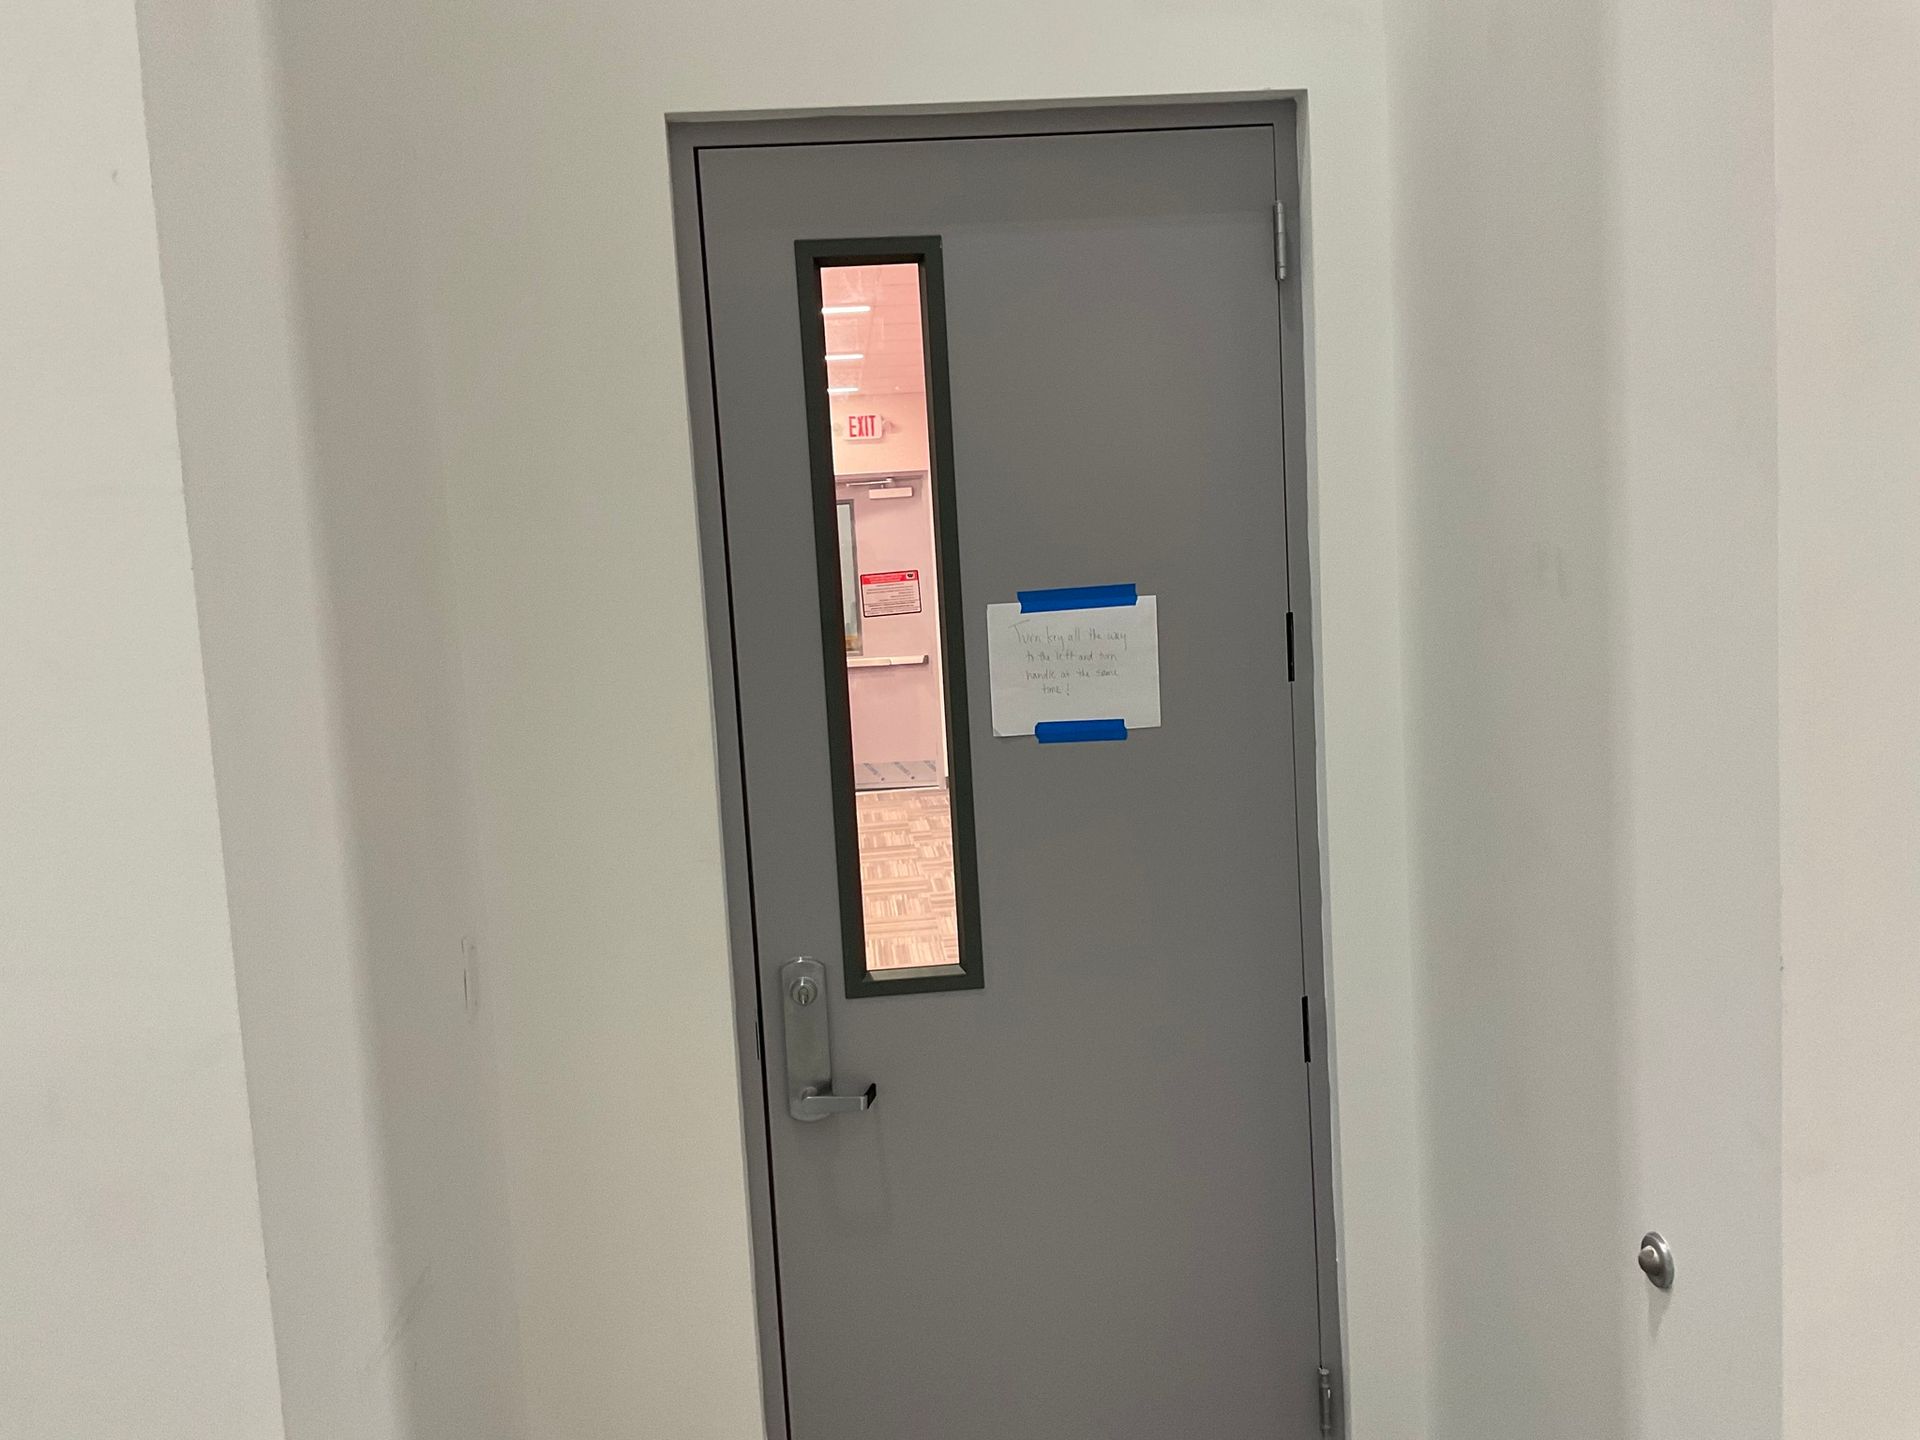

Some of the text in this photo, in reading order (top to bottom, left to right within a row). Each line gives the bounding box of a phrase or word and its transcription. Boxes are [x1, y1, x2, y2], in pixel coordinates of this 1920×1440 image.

[848, 415, 876, 437] EXIT
[1008, 619, 1128, 651] Turn key all the way
[1037, 650, 1050, 662] the
[1078, 650, 1094, 661] and
[1025, 668, 1057, 681] handle
[1075, 667, 1091, 678] the
